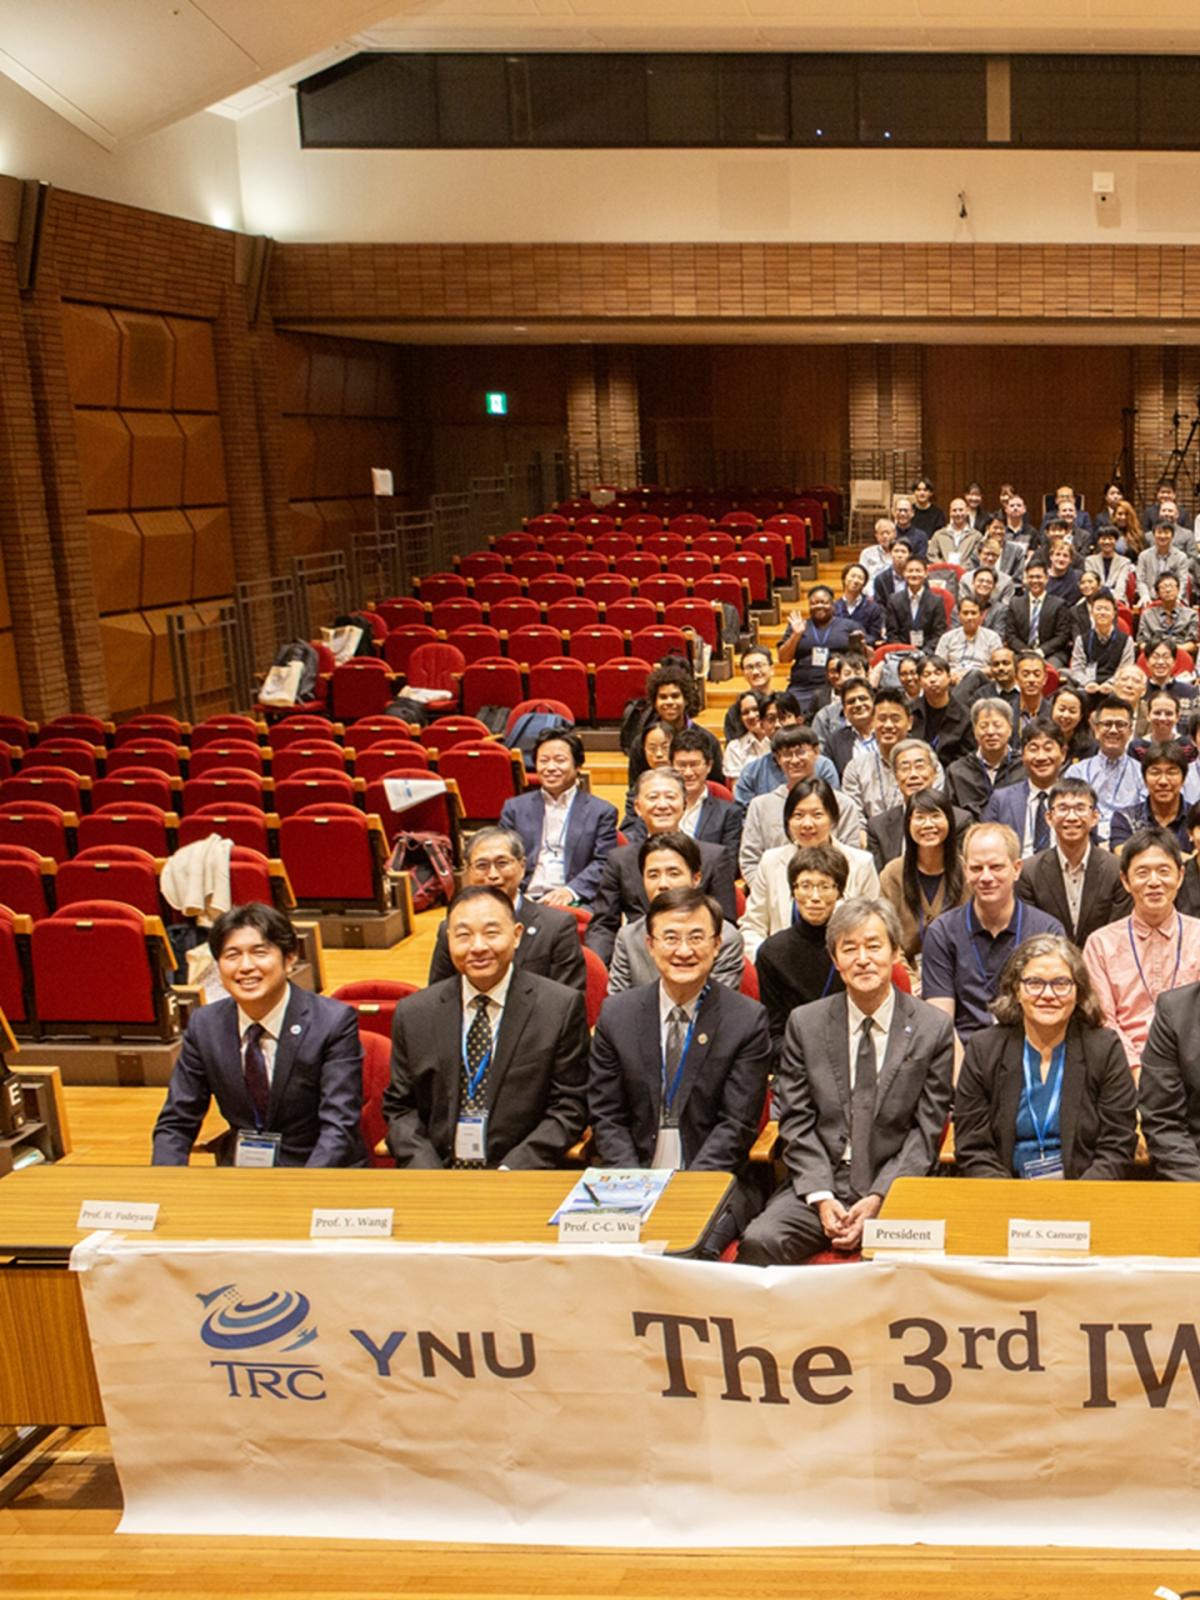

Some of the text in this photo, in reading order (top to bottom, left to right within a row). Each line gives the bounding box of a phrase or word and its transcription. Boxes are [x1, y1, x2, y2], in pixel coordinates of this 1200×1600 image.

[168, 995, 177, 1016] F
[8, 1082, 22, 1107] E
[82, 1209, 101, 1220] Prof.
[315, 1217, 388, 1229] Prof. Y. Wang
[563, 1222, 636, 1232] Prof. C-C. Wu
[876, 1227, 931, 1240] President
[1011, 1229, 1088, 1241] Prof. S. Camargo
[349, 1329, 537, 1379] YNU
[631, 1311, 854, 1406] The
[888, 1310, 1046, 1406] 3rd
[210, 1360, 327, 1401] TRC
